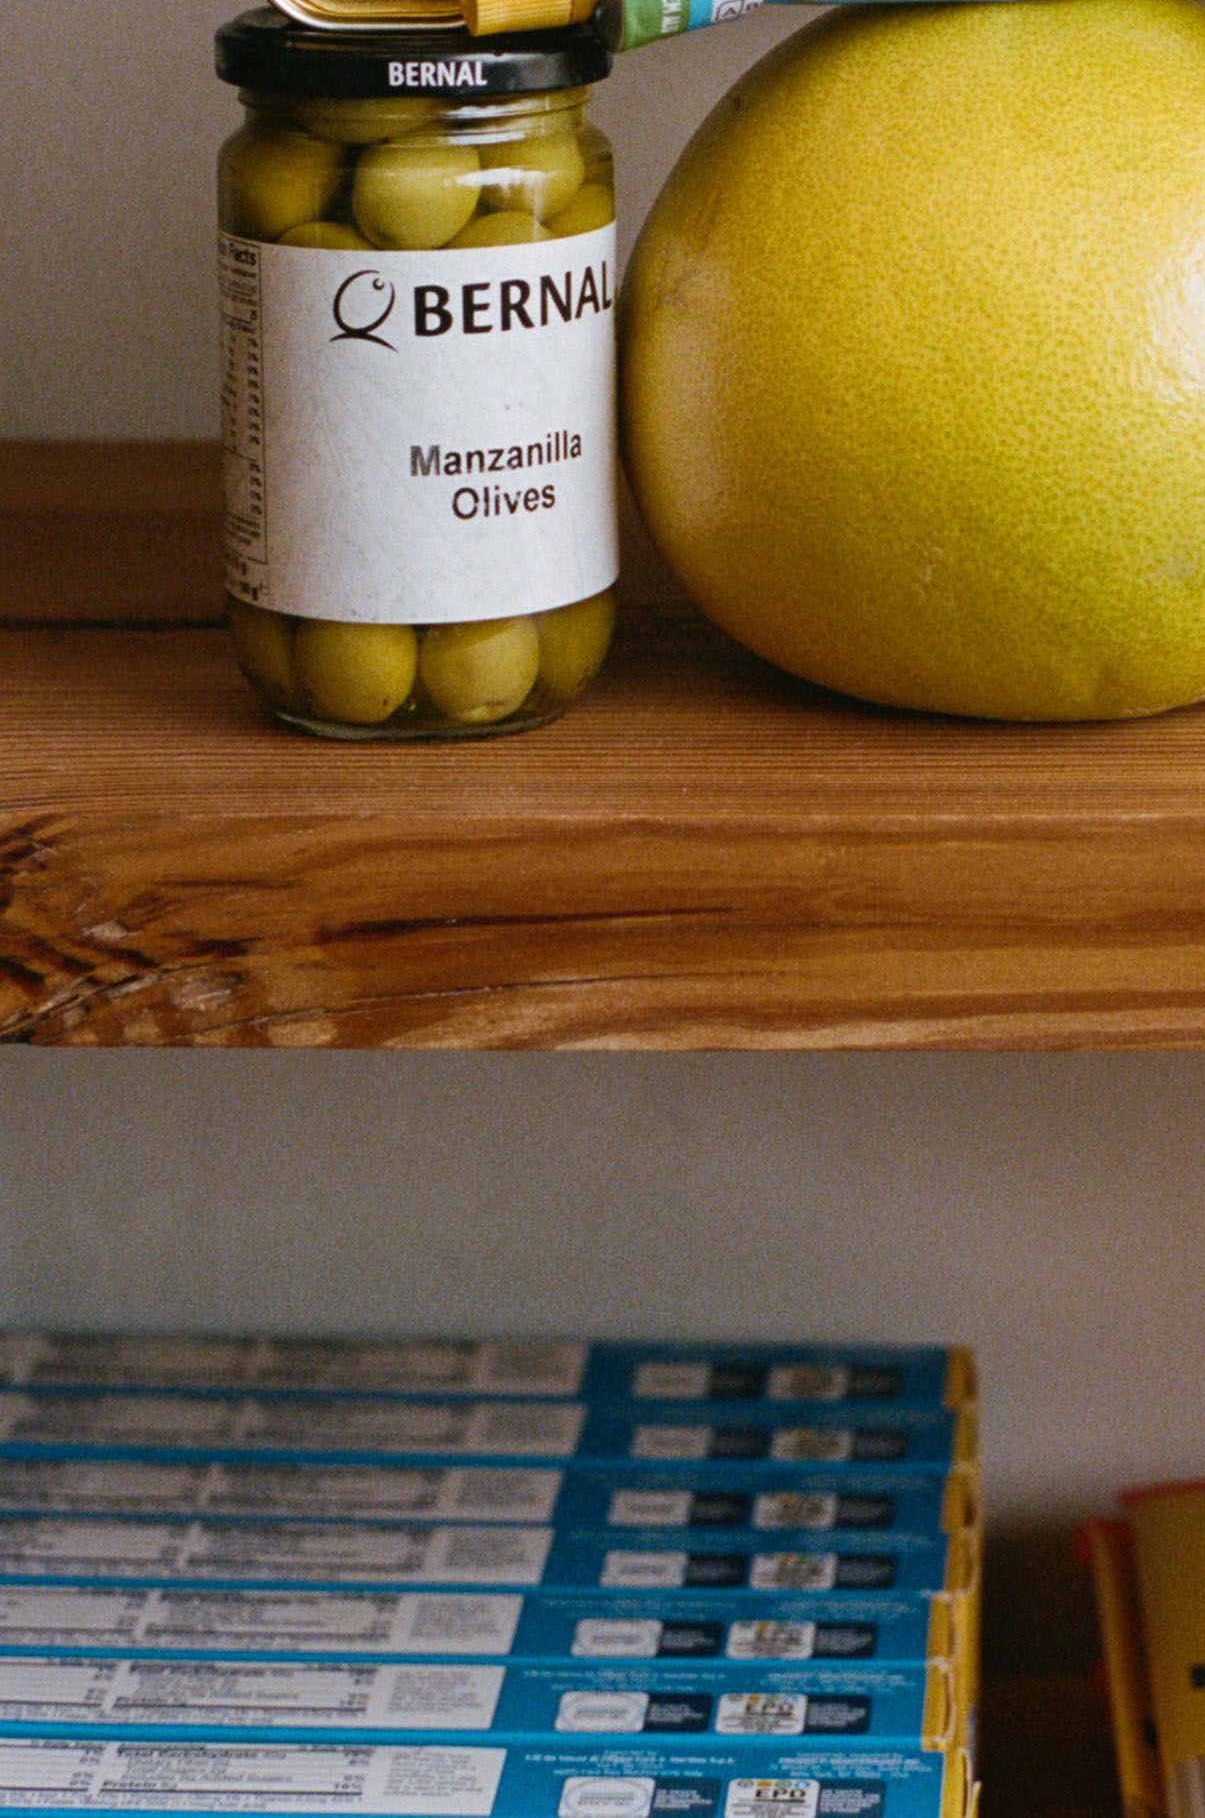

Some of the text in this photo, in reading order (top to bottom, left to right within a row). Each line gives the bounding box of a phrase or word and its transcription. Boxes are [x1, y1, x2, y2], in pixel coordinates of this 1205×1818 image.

[388, 61, 488, 87] BERNAL
[414, 261, 612, 337] BERNAL
[409, 430, 583, 478] Manzanilla
[451, 480, 556, 520] Olives
